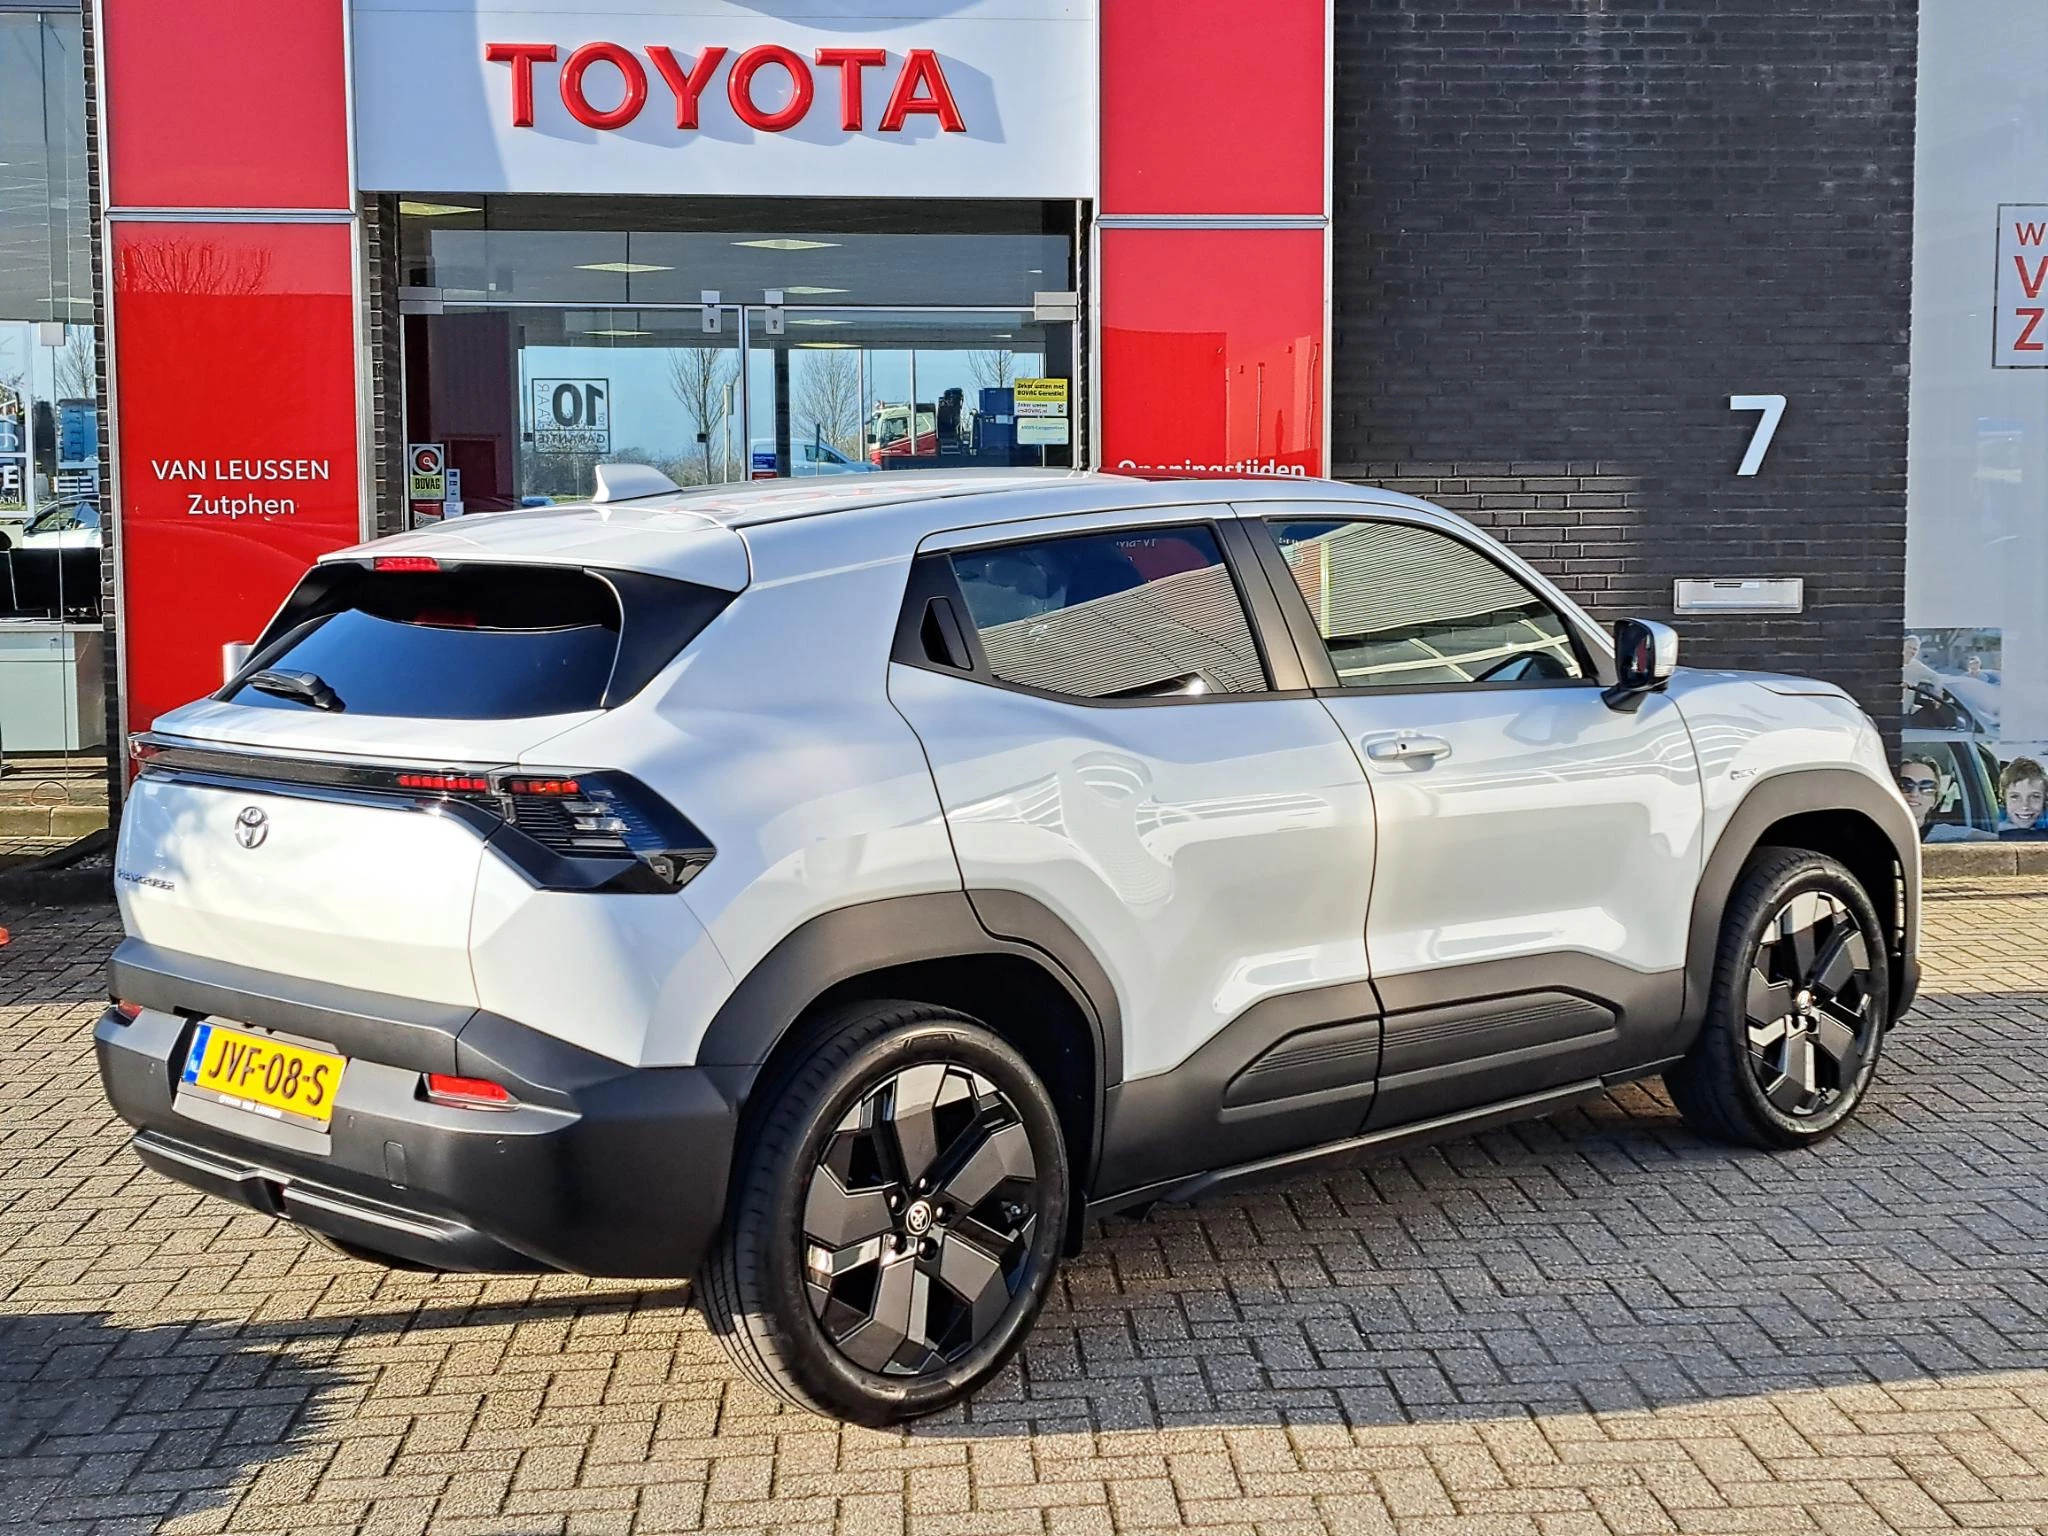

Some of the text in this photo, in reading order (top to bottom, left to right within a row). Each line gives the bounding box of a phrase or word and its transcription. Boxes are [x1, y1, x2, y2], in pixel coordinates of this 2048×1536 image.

[484, 40, 967, 133] TOYOTA
[1730, 394, 1787, 476] 7
[151, 459, 330, 480] VAN LEUSSEN
[1118, 459, 1305, 477] Oistijden
[415, 477, 440, 490] BOVAG
[187, 493, 295, 520] Zutphen
[208, 1040, 329, 1106] JVF-08-S
